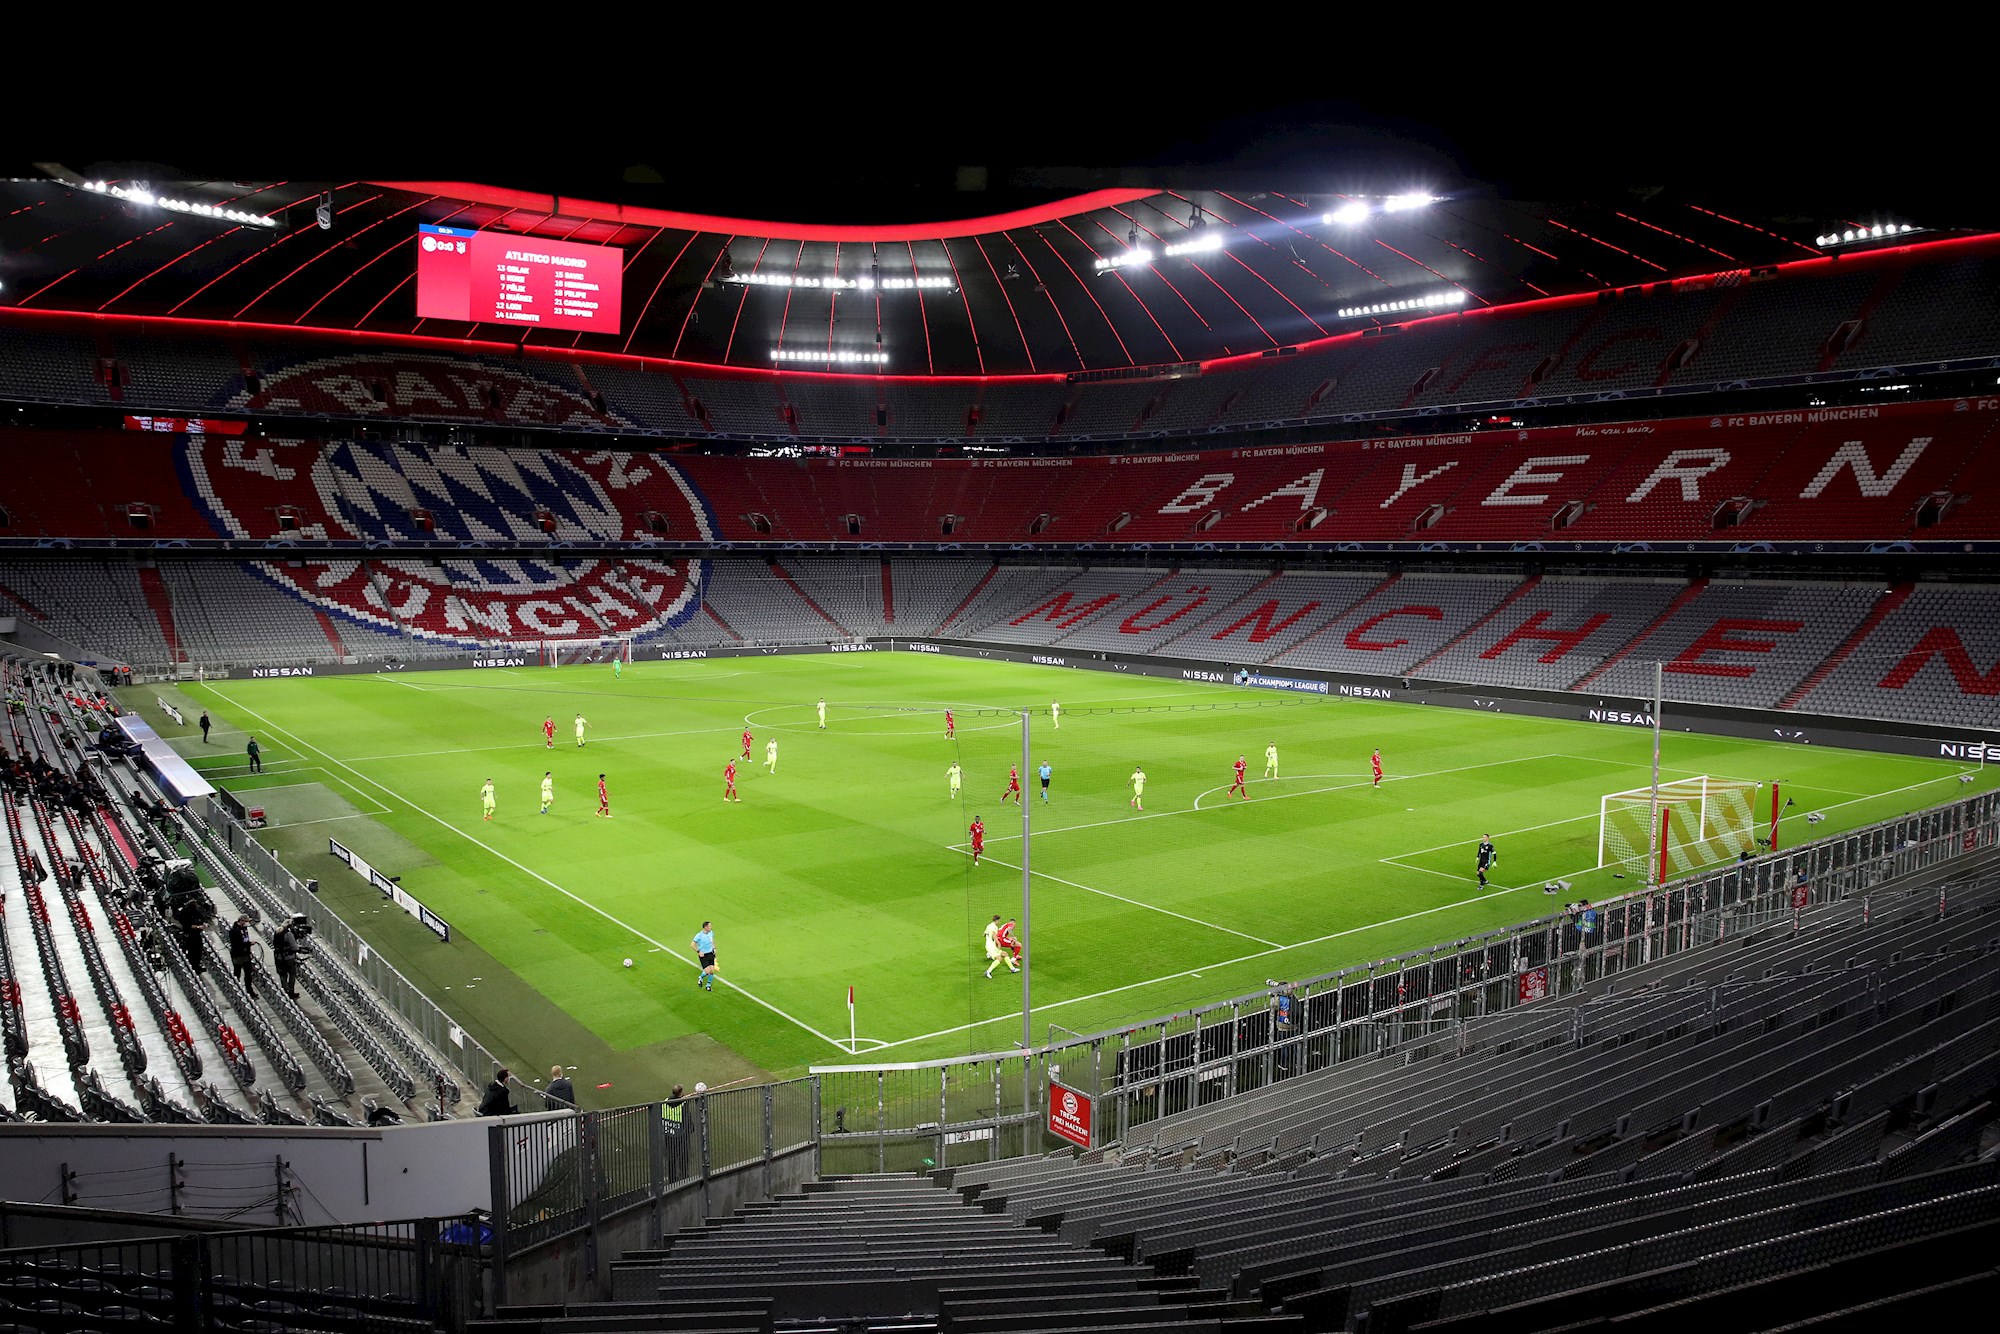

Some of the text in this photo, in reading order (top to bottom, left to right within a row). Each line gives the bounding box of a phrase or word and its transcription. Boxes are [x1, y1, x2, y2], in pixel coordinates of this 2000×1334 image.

[505, 251, 587, 268] ATLETICO MADRID
[496, 264, 506, 272] 13
[554, 298, 563, 306] 21
[1978, 400, 1998, 410] FC
[1728, 408, 1879, 427] FC BAYERN MÜNCHEN
[1374, 434, 1472, 449] FC BAYERN MÜNCHEN
[1242, 445, 1324, 458] FC BAYERN MÜNCHEN
[890, 459, 932, 468] MÜNCHEN
[1032, 458, 1073, 467] MÜNCHEN
[1121, 453, 1199, 465] FC BAYERN MÜNCHEN
[1158, 436, 1934, 514] BAYERN
[832, 644, 872, 652] NISSAN
[909, 643, 940, 653] NISSAN
[662, 650, 707, 659] NISSAN
[473, 658, 524, 668] NISSAN
[1032, 655, 1065, 666] NISSAN
[253, 667, 312, 678] NISSAN
[1183, 670, 1224, 682] NISSAN
[1258, 677, 1294, 688] CHAMPIONS
[1294, 681, 1318, 691] LEAGUE
[1339, 685, 1391, 698] NISSAN
[1589, 709, 1655, 726] NISSAN
[1052, 1115, 1065, 1125] FREI
[1060, 1109, 1081, 1124] TREPPE
